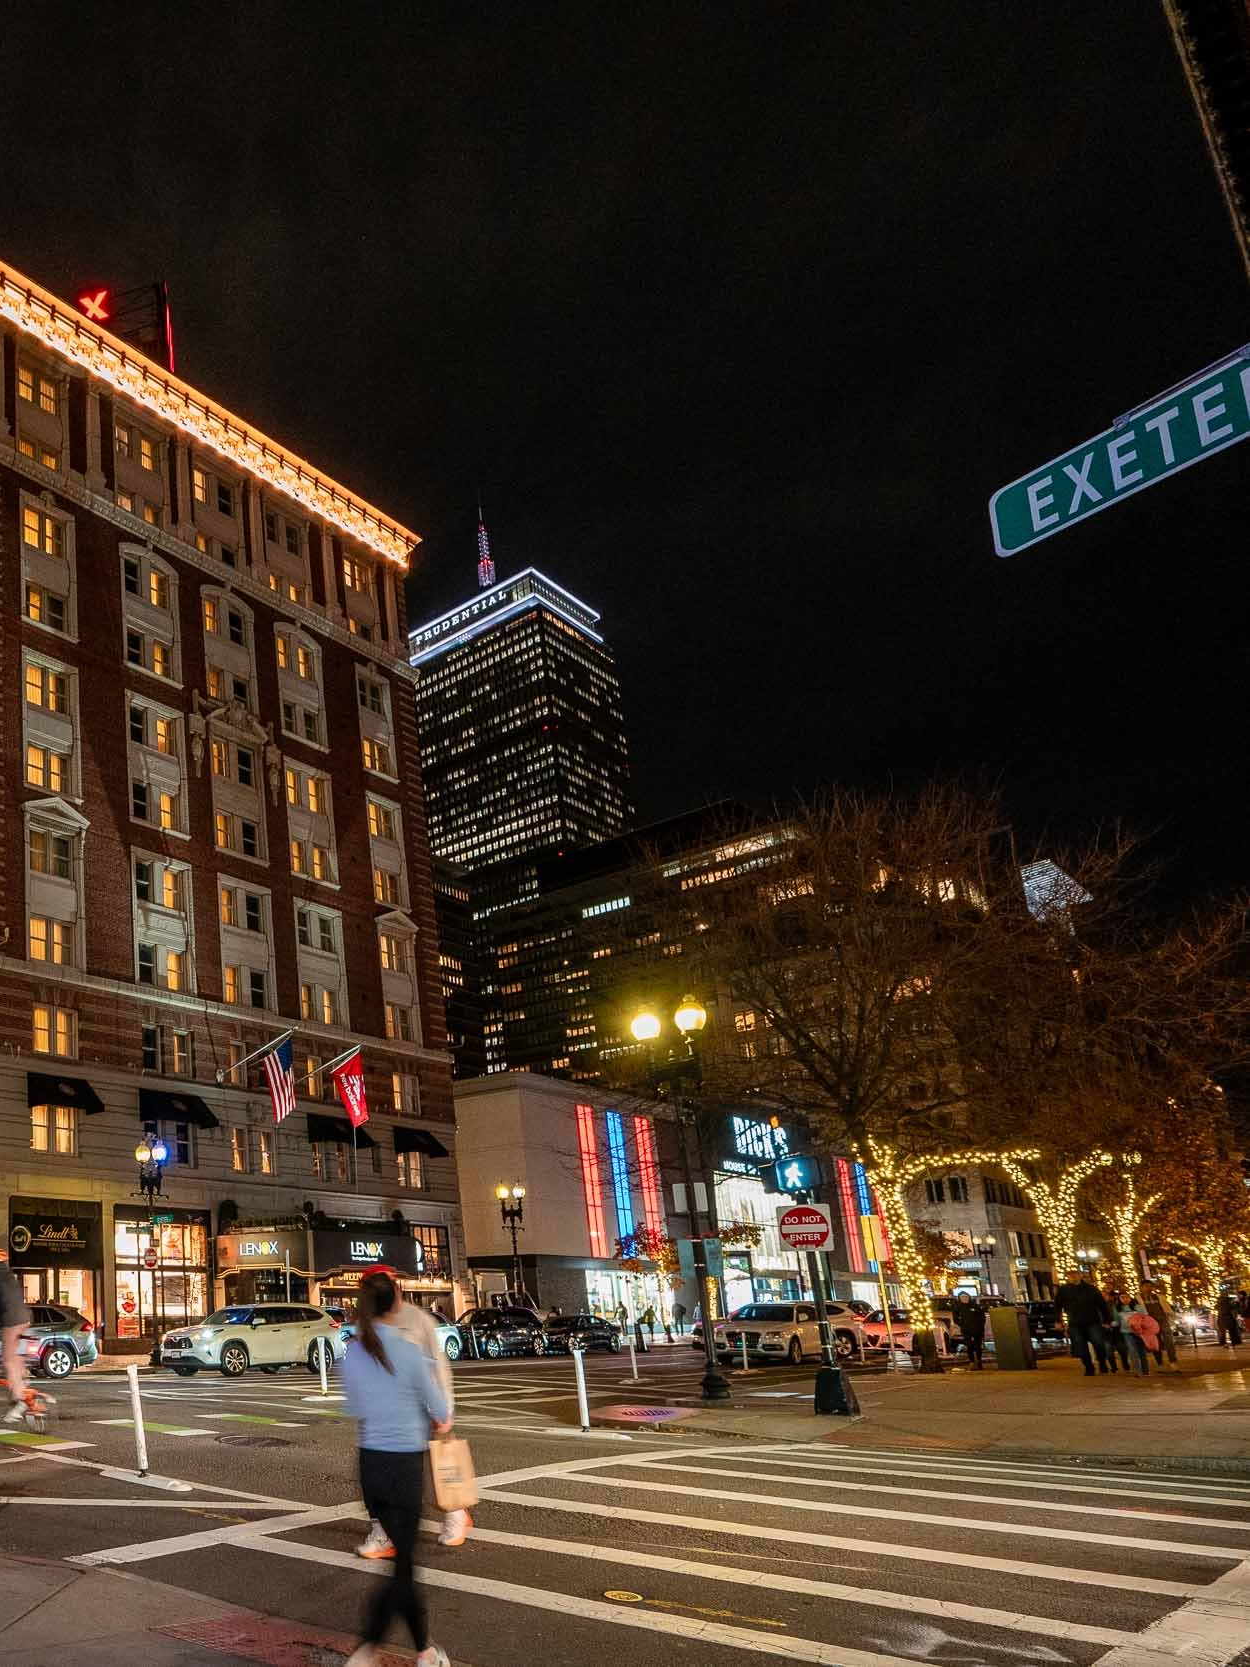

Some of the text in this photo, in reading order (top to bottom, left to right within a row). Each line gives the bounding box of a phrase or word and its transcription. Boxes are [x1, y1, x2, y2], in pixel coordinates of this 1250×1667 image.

[1026, 366, 1250, 532] EXETE
[415, 591, 507, 645] PRUDENTIAL
[732, 1116, 790, 1160] DICK'S
[784, 1215, 822, 1225] DO NOT
[37, 1224, 70, 1239] Lindt
[789, 1233, 822, 1242] ENTER
[239, 1241, 279, 1256] LENOX
[350, 1241, 384, 1257] LENOX
